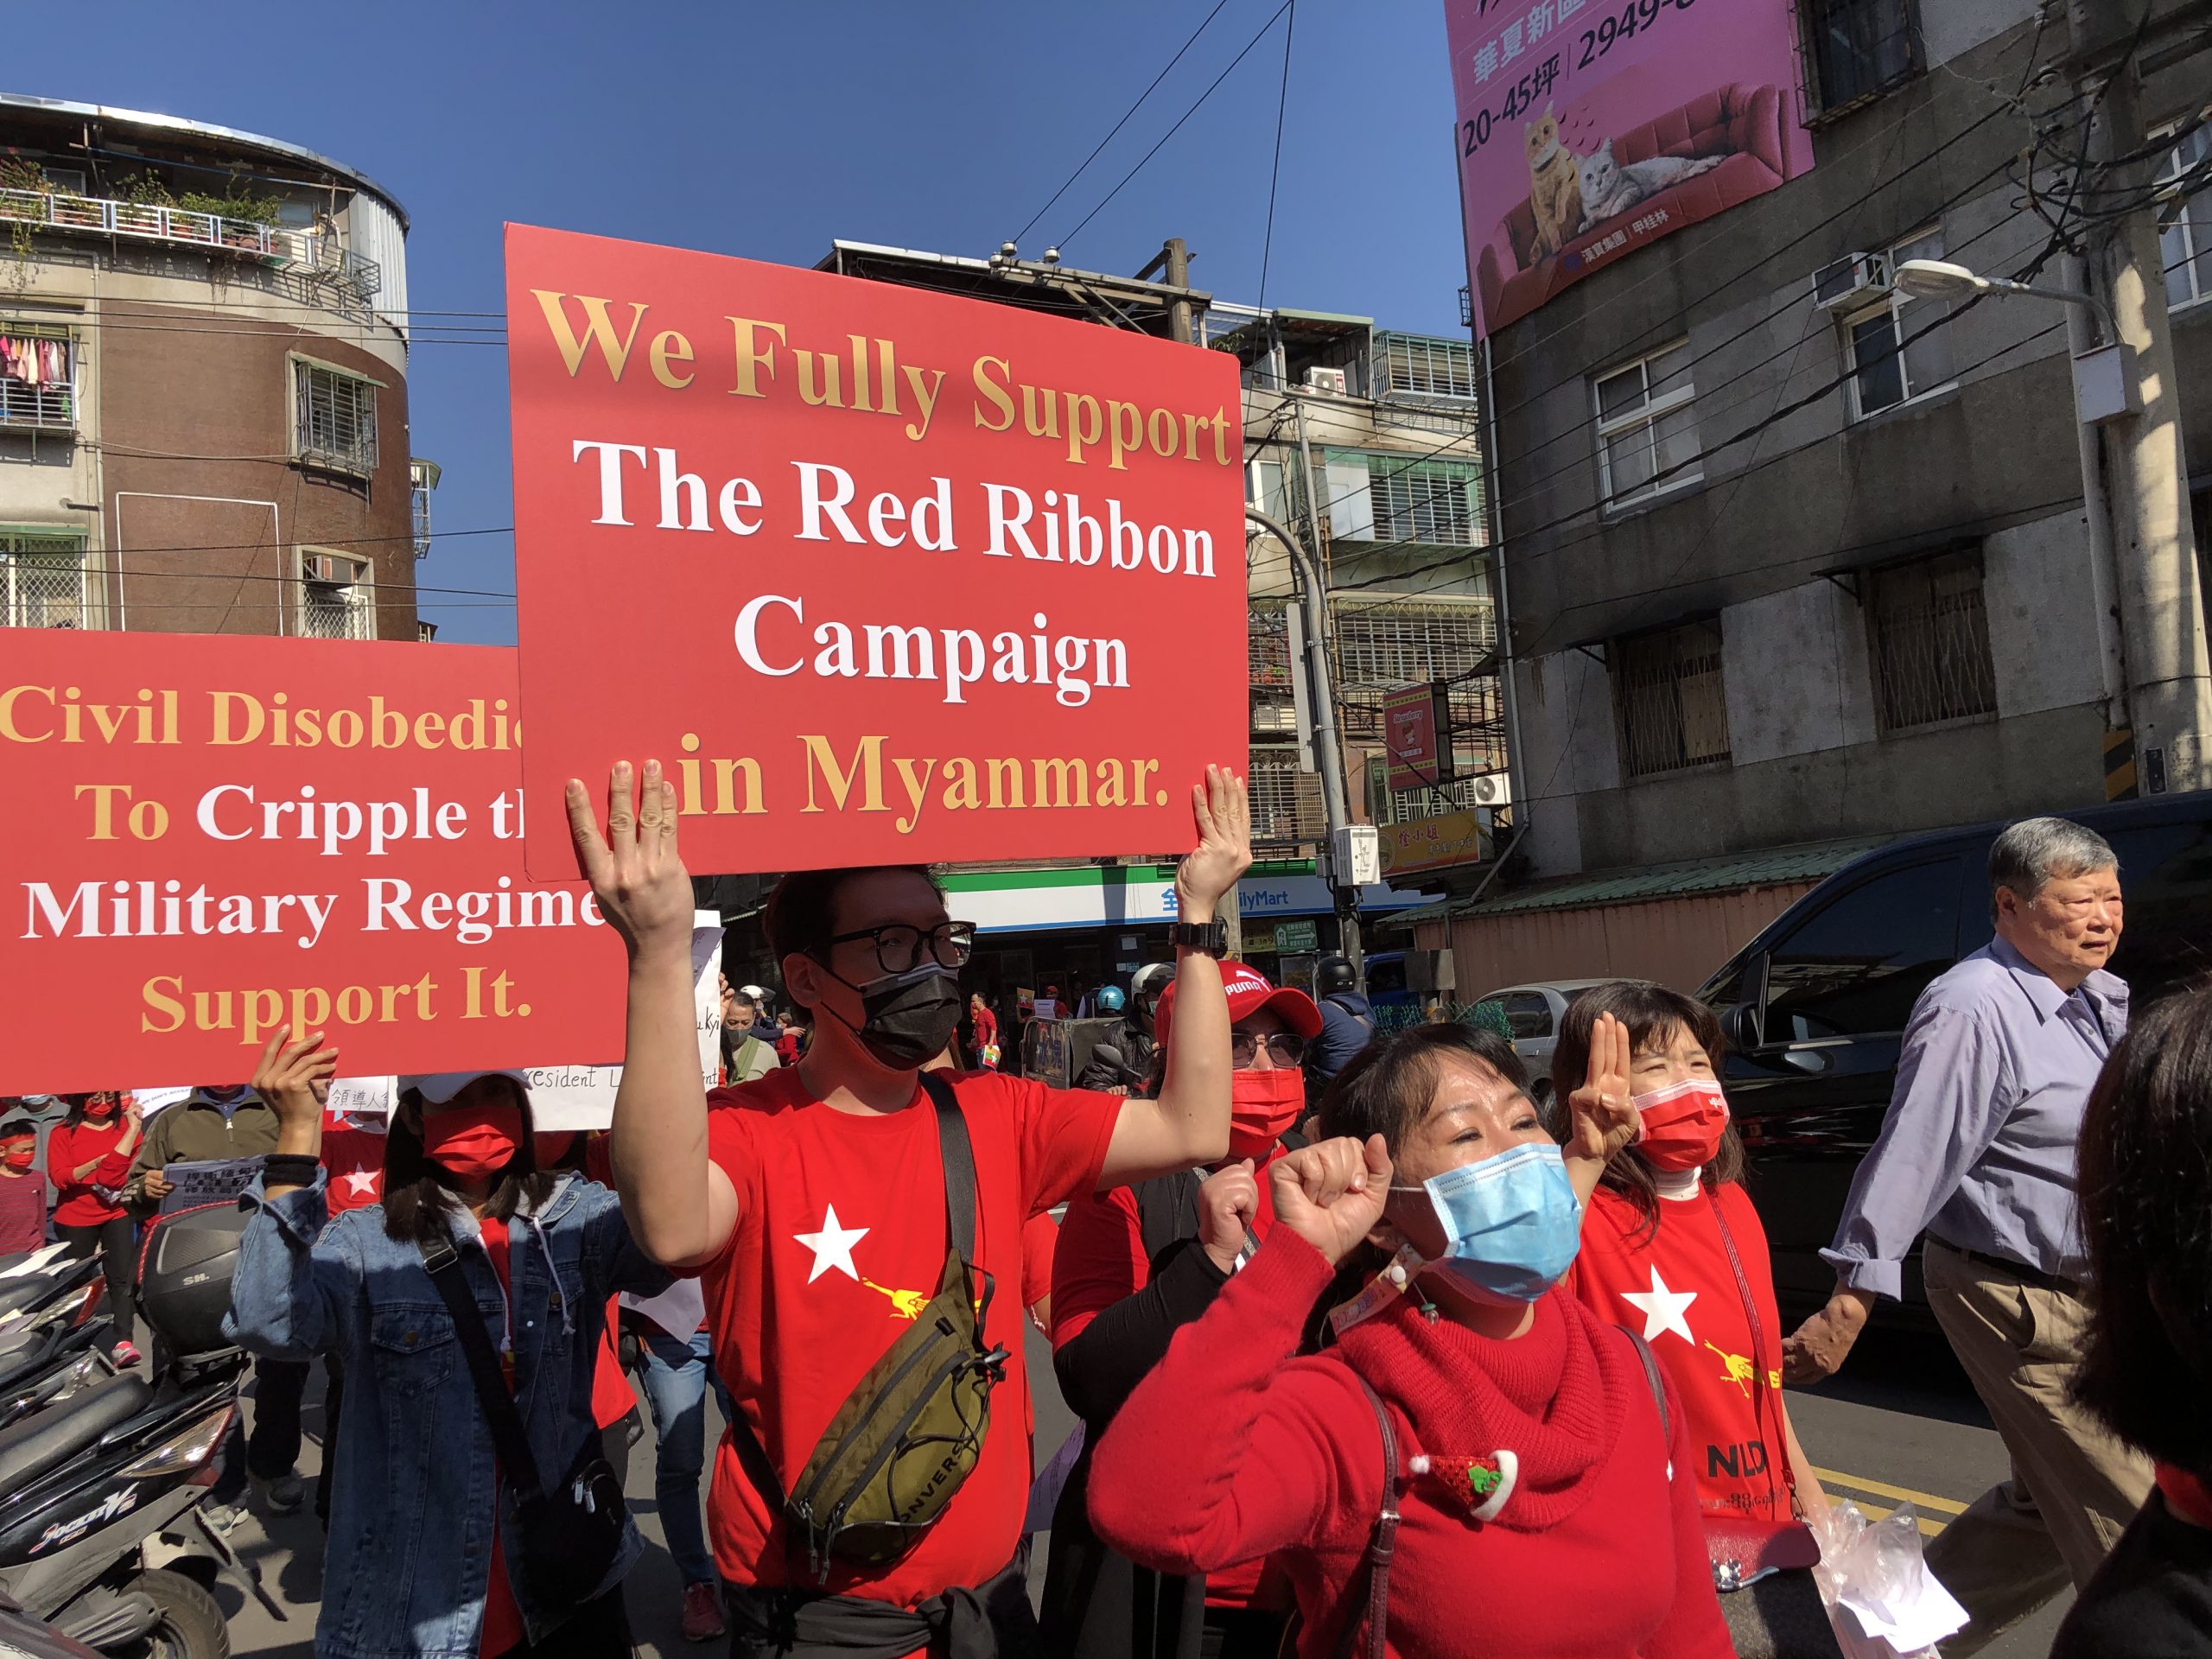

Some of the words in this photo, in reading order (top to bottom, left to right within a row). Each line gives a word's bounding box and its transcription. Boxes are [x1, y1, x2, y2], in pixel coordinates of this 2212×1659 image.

[1463, 52, 1560, 159] 20-45坪
[530, 289, 694, 388] We
[724, 316, 945, 440] Fully
[973, 356, 1230, 470] Support
[573, 440, 762, 535] The
[791, 461, 958, 551] Red
[980, 483, 1216, 577] Ribbon
[734, 595, 1130, 706] Campaign
[0, 686, 181, 743] Civil
[207, 692, 521, 750] Disobedi
[678, 734, 767, 815] in
[797, 735, 1167, 833] Myanmar.
[75, 785, 168, 840] To
[197, 785, 467, 855] Cripple
[20, 880, 338, 948] Military
[360, 876, 605, 944] Regime
[1238, 891, 1289, 911] ilyMart
[143, 973, 438, 1044] Support
[461, 968, 531, 1018] It.
[1224, 981, 1263, 996] PUMA
[524, 1065, 596, 1089] resident
[1707, 1440, 1767, 1478] NLD
